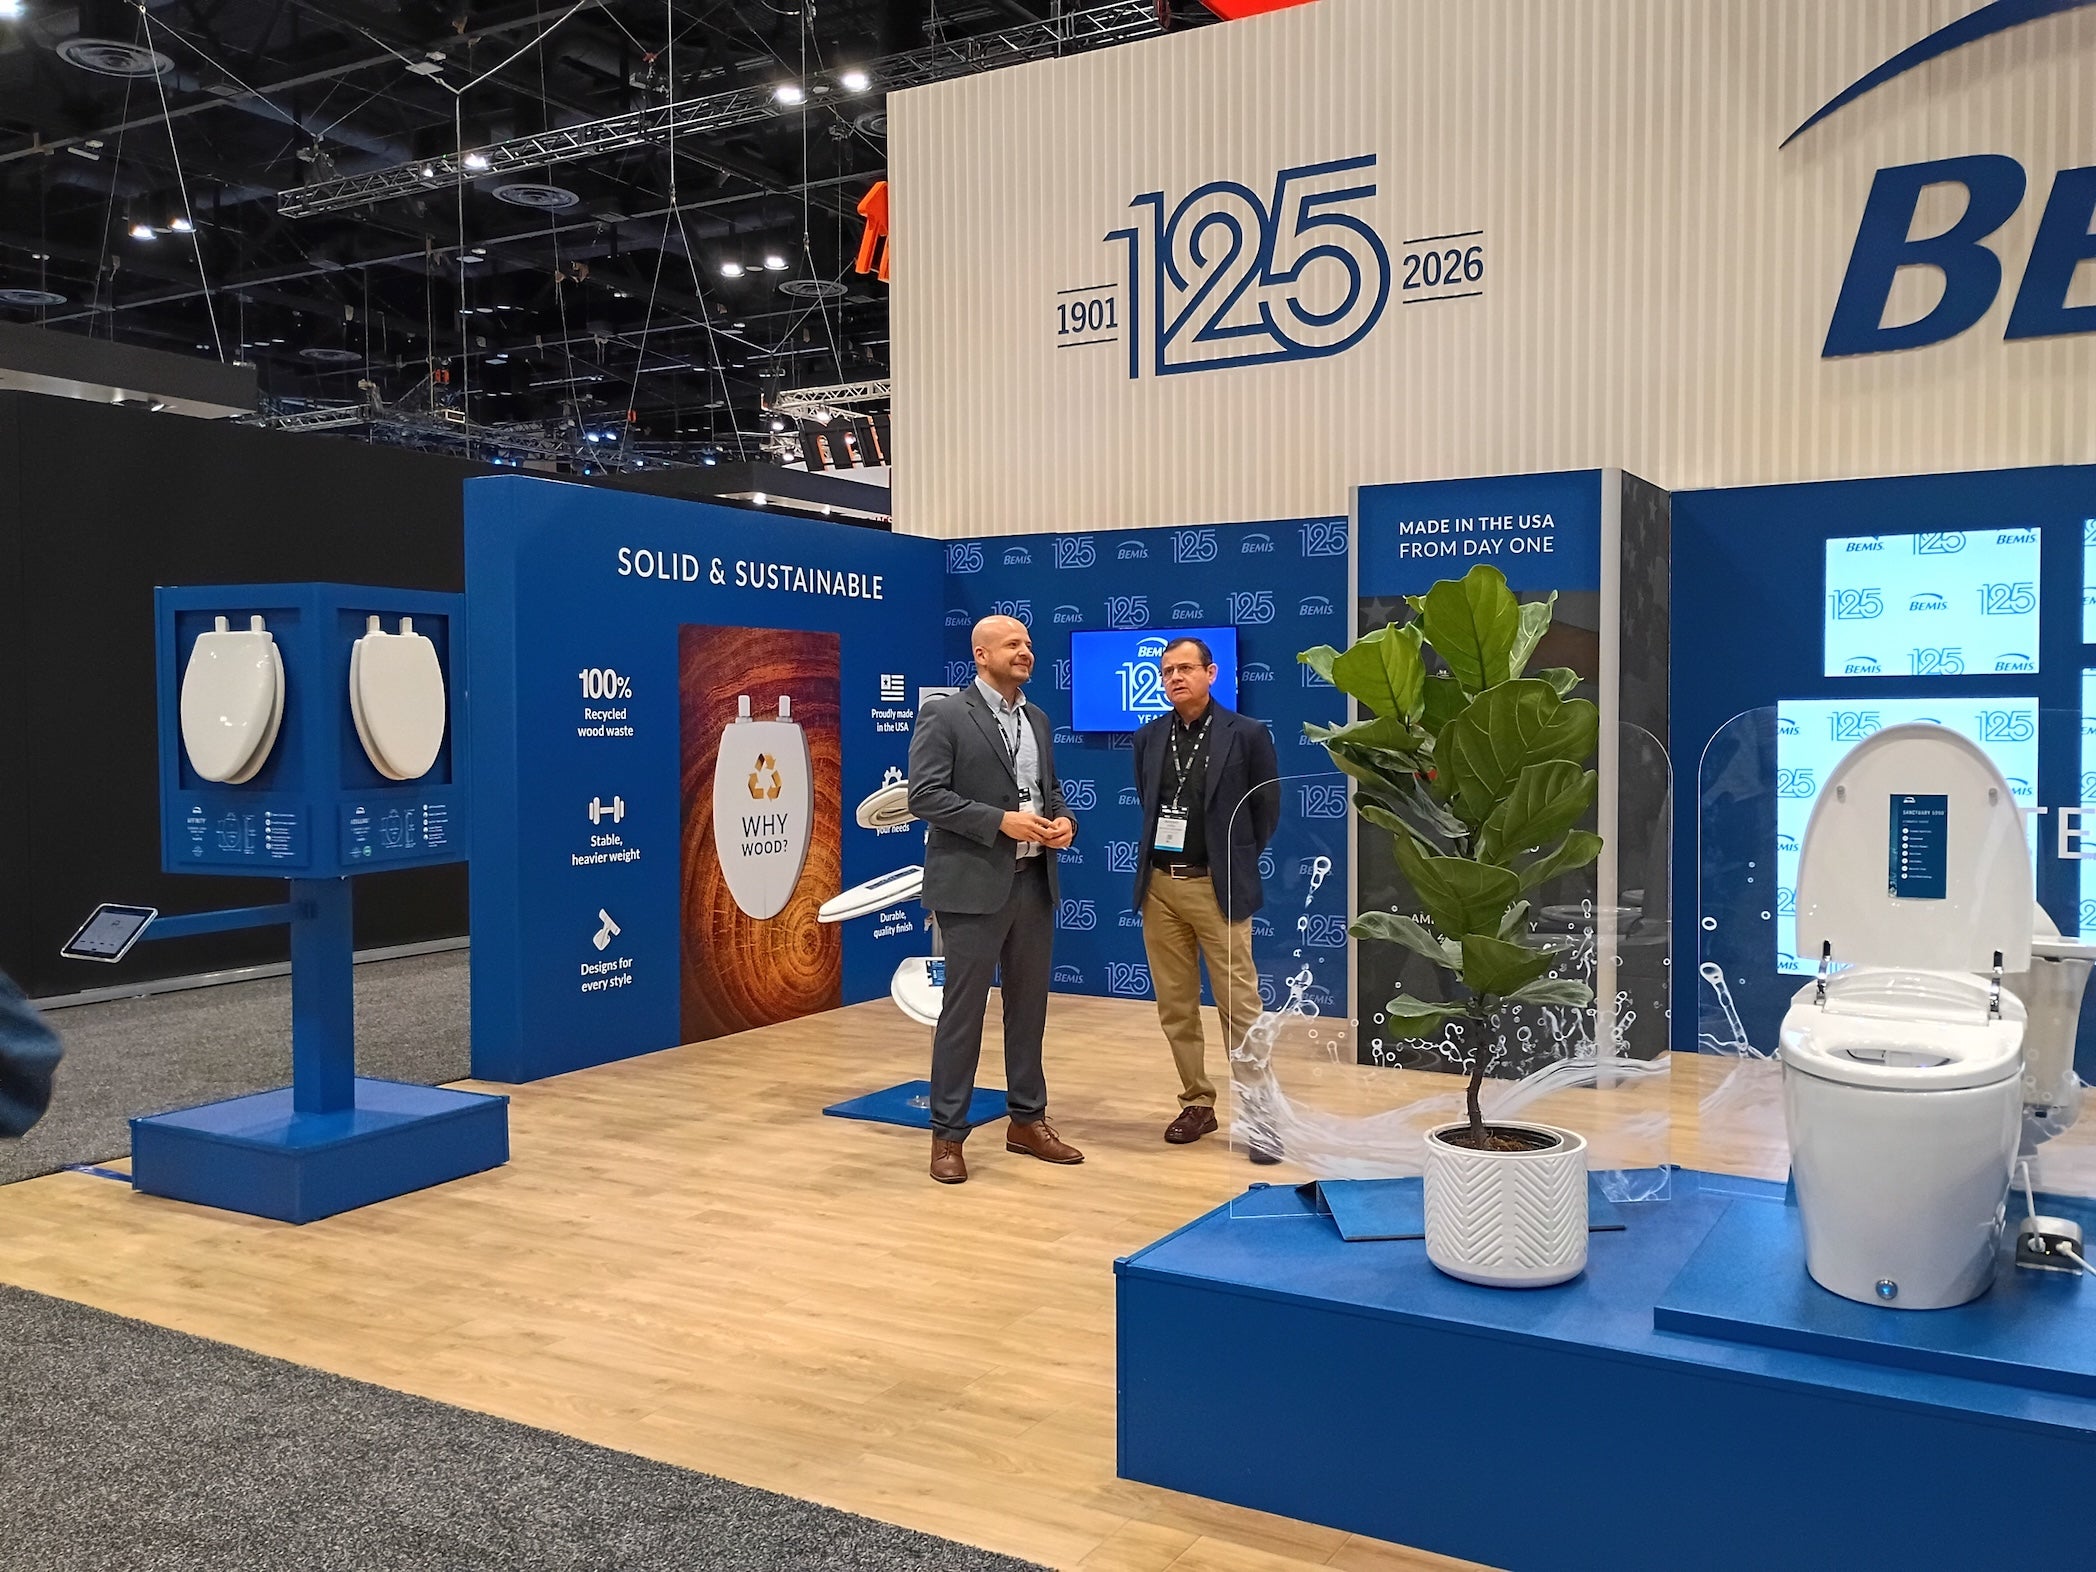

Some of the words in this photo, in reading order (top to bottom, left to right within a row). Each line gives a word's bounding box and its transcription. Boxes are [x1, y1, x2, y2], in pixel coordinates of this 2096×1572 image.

[1103, 153, 1391, 379] 125
[1402, 245, 1484, 290] 2026
[1057, 297, 1118, 335] 1901
[1399, 519, 1450, 536] MADE
[1455, 517, 1474, 533] IN
[1478, 515, 1513, 531] THE
[1518, 514, 1555, 529] USA
[1170, 529, 1218, 564] 125
[1241, 542, 1275, 554] BEMIS
[1298, 521, 1349, 557] 125
[1400, 540, 1457, 559] FROM
[1463, 538, 1504, 556] DAY
[1509, 536, 1554, 554] ONE
[1846, 541, 1885, 552] BEMIS
[1996, 534, 2037, 545] BEMIS
[944, 542, 984, 574] 125
[1003, 554, 1033, 565] BEMIS
[1051, 536, 1096, 569] 125
[1117, 548, 1149, 560] BEMIS
[617, 547, 700, 582] SOLID
[709, 557, 726, 585] &
[735, 560, 884, 600] SUSTAINABLE
[1226, 590, 1276, 625] 125
[1828, 587, 1884, 620] 125
[1909, 601, 1948, 611] BEMIS
[1976, 581, 2036, 616] 125
[1053, 613, 1084, 624] BEMIS
[1104, 595, 1150, 628] 125
[1171, 608, 1204, 620] BEMIS
[1299, 604, 1334, 616] BEMIS
[944, 616, 971, 627] BEMIS
[1137, 646, 1166, 658] BEM
[1844, 664, 1882, 674] BEMIS
[1907, 647, 1965, 676] 125
[1994, 661, 2034, 672] BEMIS
[578, 667, 633, 700] 100%
[1241, 671, 1275, 682] BEMIS
[1115, 661, 1175, 712] 12
[584, 707, 627, 723] Recycled
[871, 708, 896, 720] Proudly
[897, 708, 914, 719] made
[577, 724, 605, 737] wood
[606, 725, 634, 737] waste
[876, 722, 884, 732] in
[884, 722, 895, 732] the
[895, 722, 909, 732] USA
[1975, 710, 2034, 742] 125
[1053, 733, 1084, 744] BEMIS
[1777, 768, 1816, 798] 25
[1118, 794, 1140, 806] BEM
[1298, 784, 1348, 819] 125
[741, 812, 788, 838] WHY
[590, 833, 623, 848] Stable,
[741, 839, 788, 857] WOOD?
[571, 852, 608, 866] heavier
[609, 848, 641, 863] weight
[880, 910, 907, 923] Durable,
[1056, 899, 1098, 931] 125
[1118, 916, 1143, 928] BEMI
[873, 924, 896, 939] quality
[896, 921, 914, 934] finish
[1250, 926, 1275, 937] EMIS
[580, 959, 618, 976] Designs
[618, 956, 633, 970] for
[581, 977, 609, 993] every
[609, 973, 633, 989] style
[1054, 972, 1085, 984] BEMIS
[1104, 962, 1150, 995] 125
